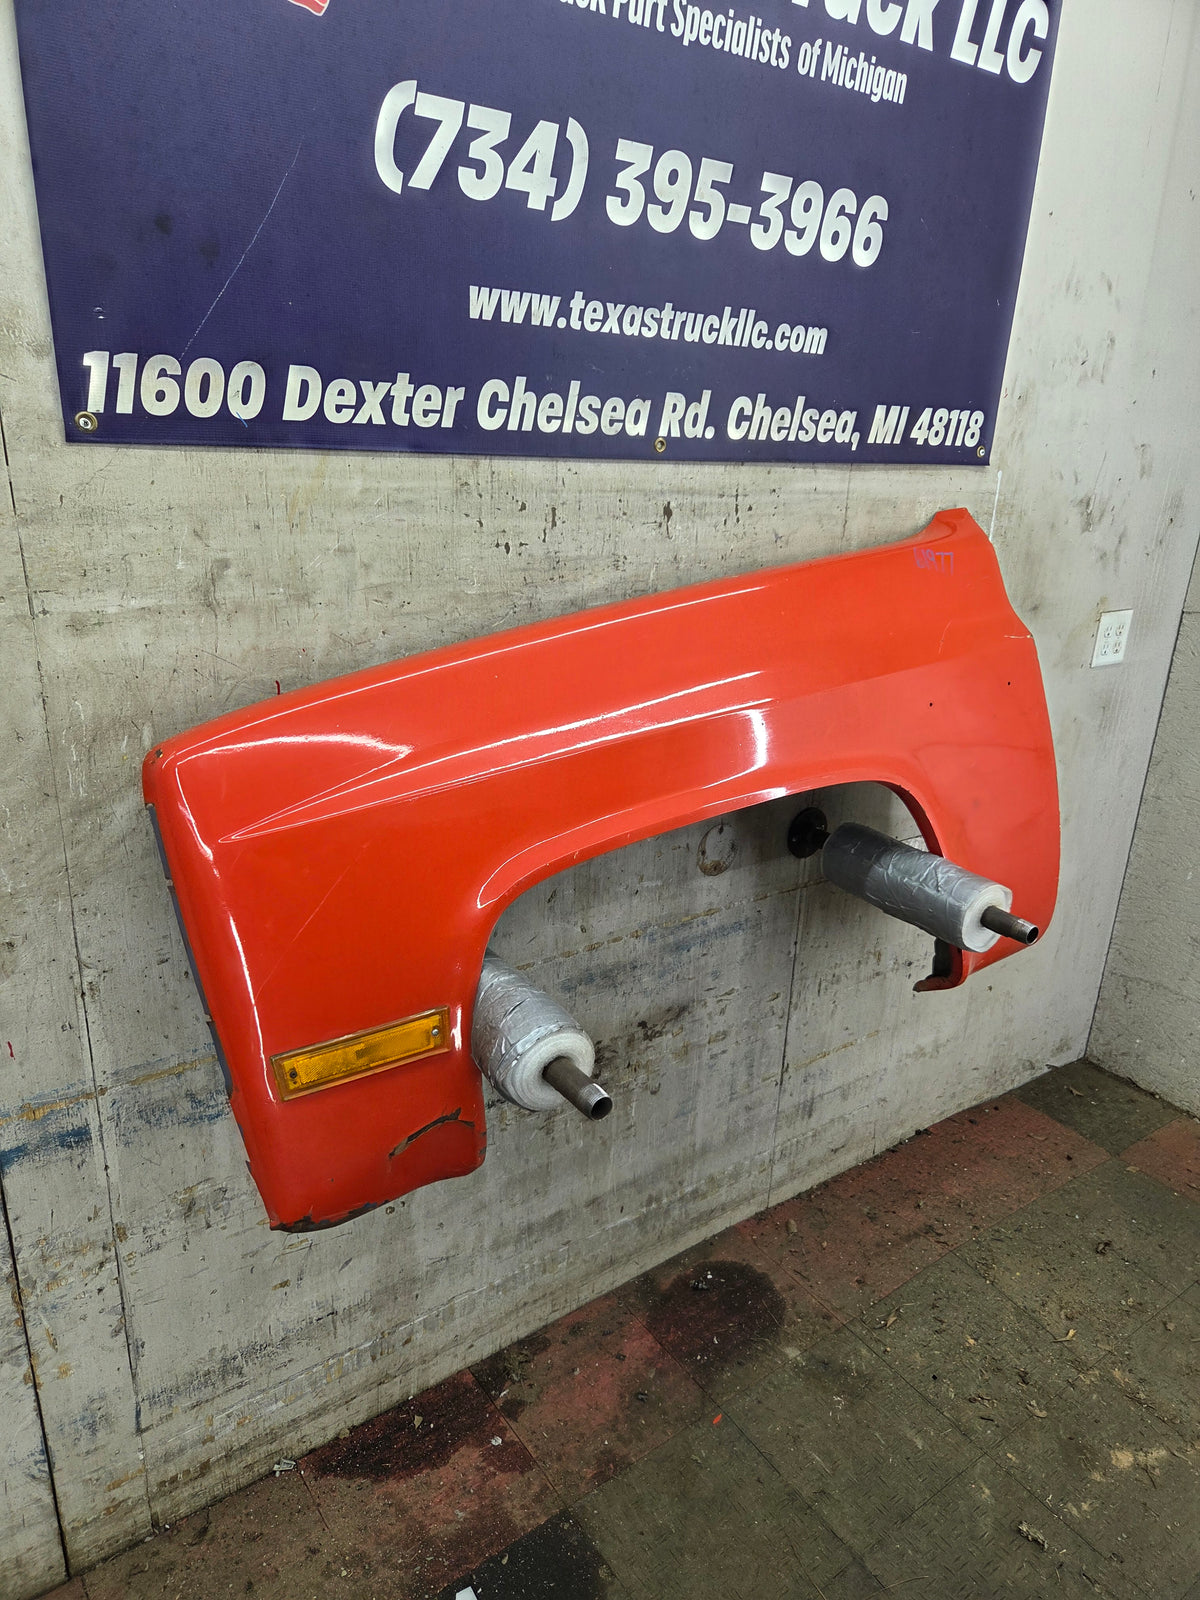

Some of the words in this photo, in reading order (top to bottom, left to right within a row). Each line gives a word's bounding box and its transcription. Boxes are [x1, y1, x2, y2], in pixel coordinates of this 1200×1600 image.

[669, 0, 792, 70] Specialists
[797, 38, 823, 78] of
[820, 40, 908, 105] Michigan
[949, 0, 1050, 84] LLC
[374, 79, 589, 222] (734)
[605, 137, 889, 268] 395-3966
[469, 285, 828, 355] www.texastruckllc.com
[82, 350, 266, 420] 11600
[282, 364, 466, 429] Dexter
[476, 376, 652, 437] Chelsea
[657, 389, 715, 440] Rd.
[726, 395, 861, 451] Chelsea,
[866, 404, 911, 445] MI
[909, 406, 985, 448] 48118
